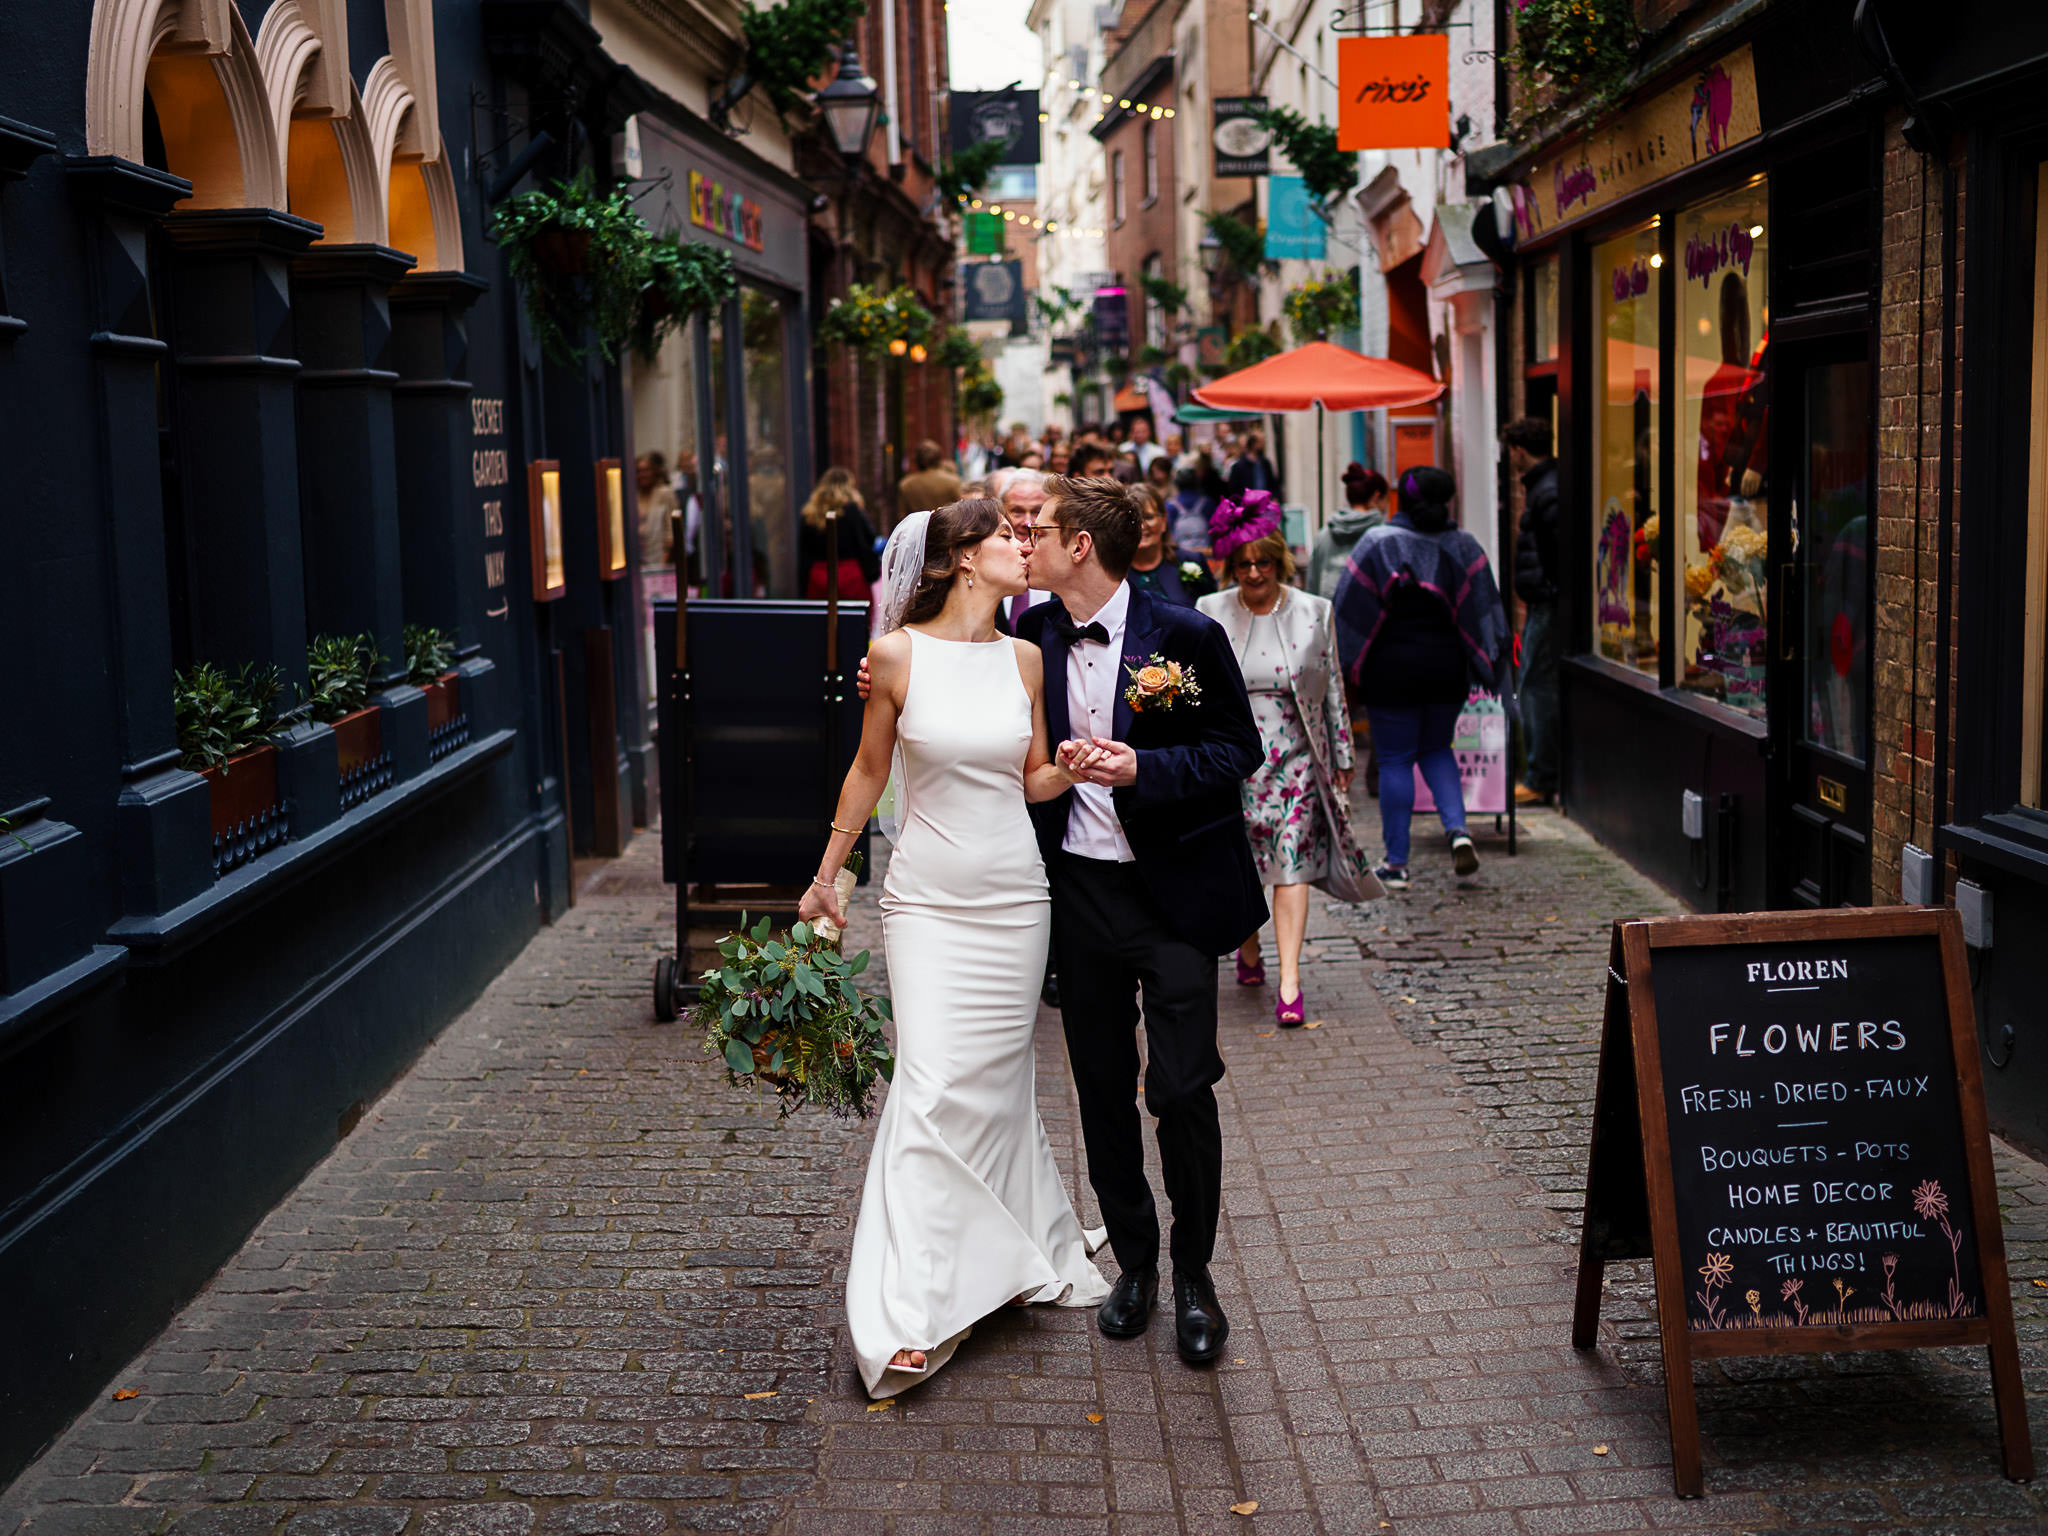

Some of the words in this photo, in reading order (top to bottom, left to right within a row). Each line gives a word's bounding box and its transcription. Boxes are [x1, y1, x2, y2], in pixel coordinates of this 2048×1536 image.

[472, 398, 503, 436] SECRET
[473, 449, 508, 488] GARDEN
[483, 500, 503, 537] THIS
[485, 551, 505, 588] WAY
[1746, 959, 1848, 983] FLOREN
[1709, 1020, 1907, 1057] FLOWERS
[1680, 1084, 1752, 1114] FRESH
[1774, 1081, 1847, 1105] DRIED
[1866, 1075, 1929, 1098] FAUX
[1700, 1145, 1827, 1172] BOUQUETS
[1855, 1141, 1910, 1161] POTS
[1728, 1183, 1800, 1209] HOME
[1813, 1182, 1894, 1204] DECOR
[1707, 1226, 1802, 1247] CANDLES
[1826, 1221, 1925, 1242] BEAUTIFUL
[1767, 1252, 1866, 1274] THINGS!
